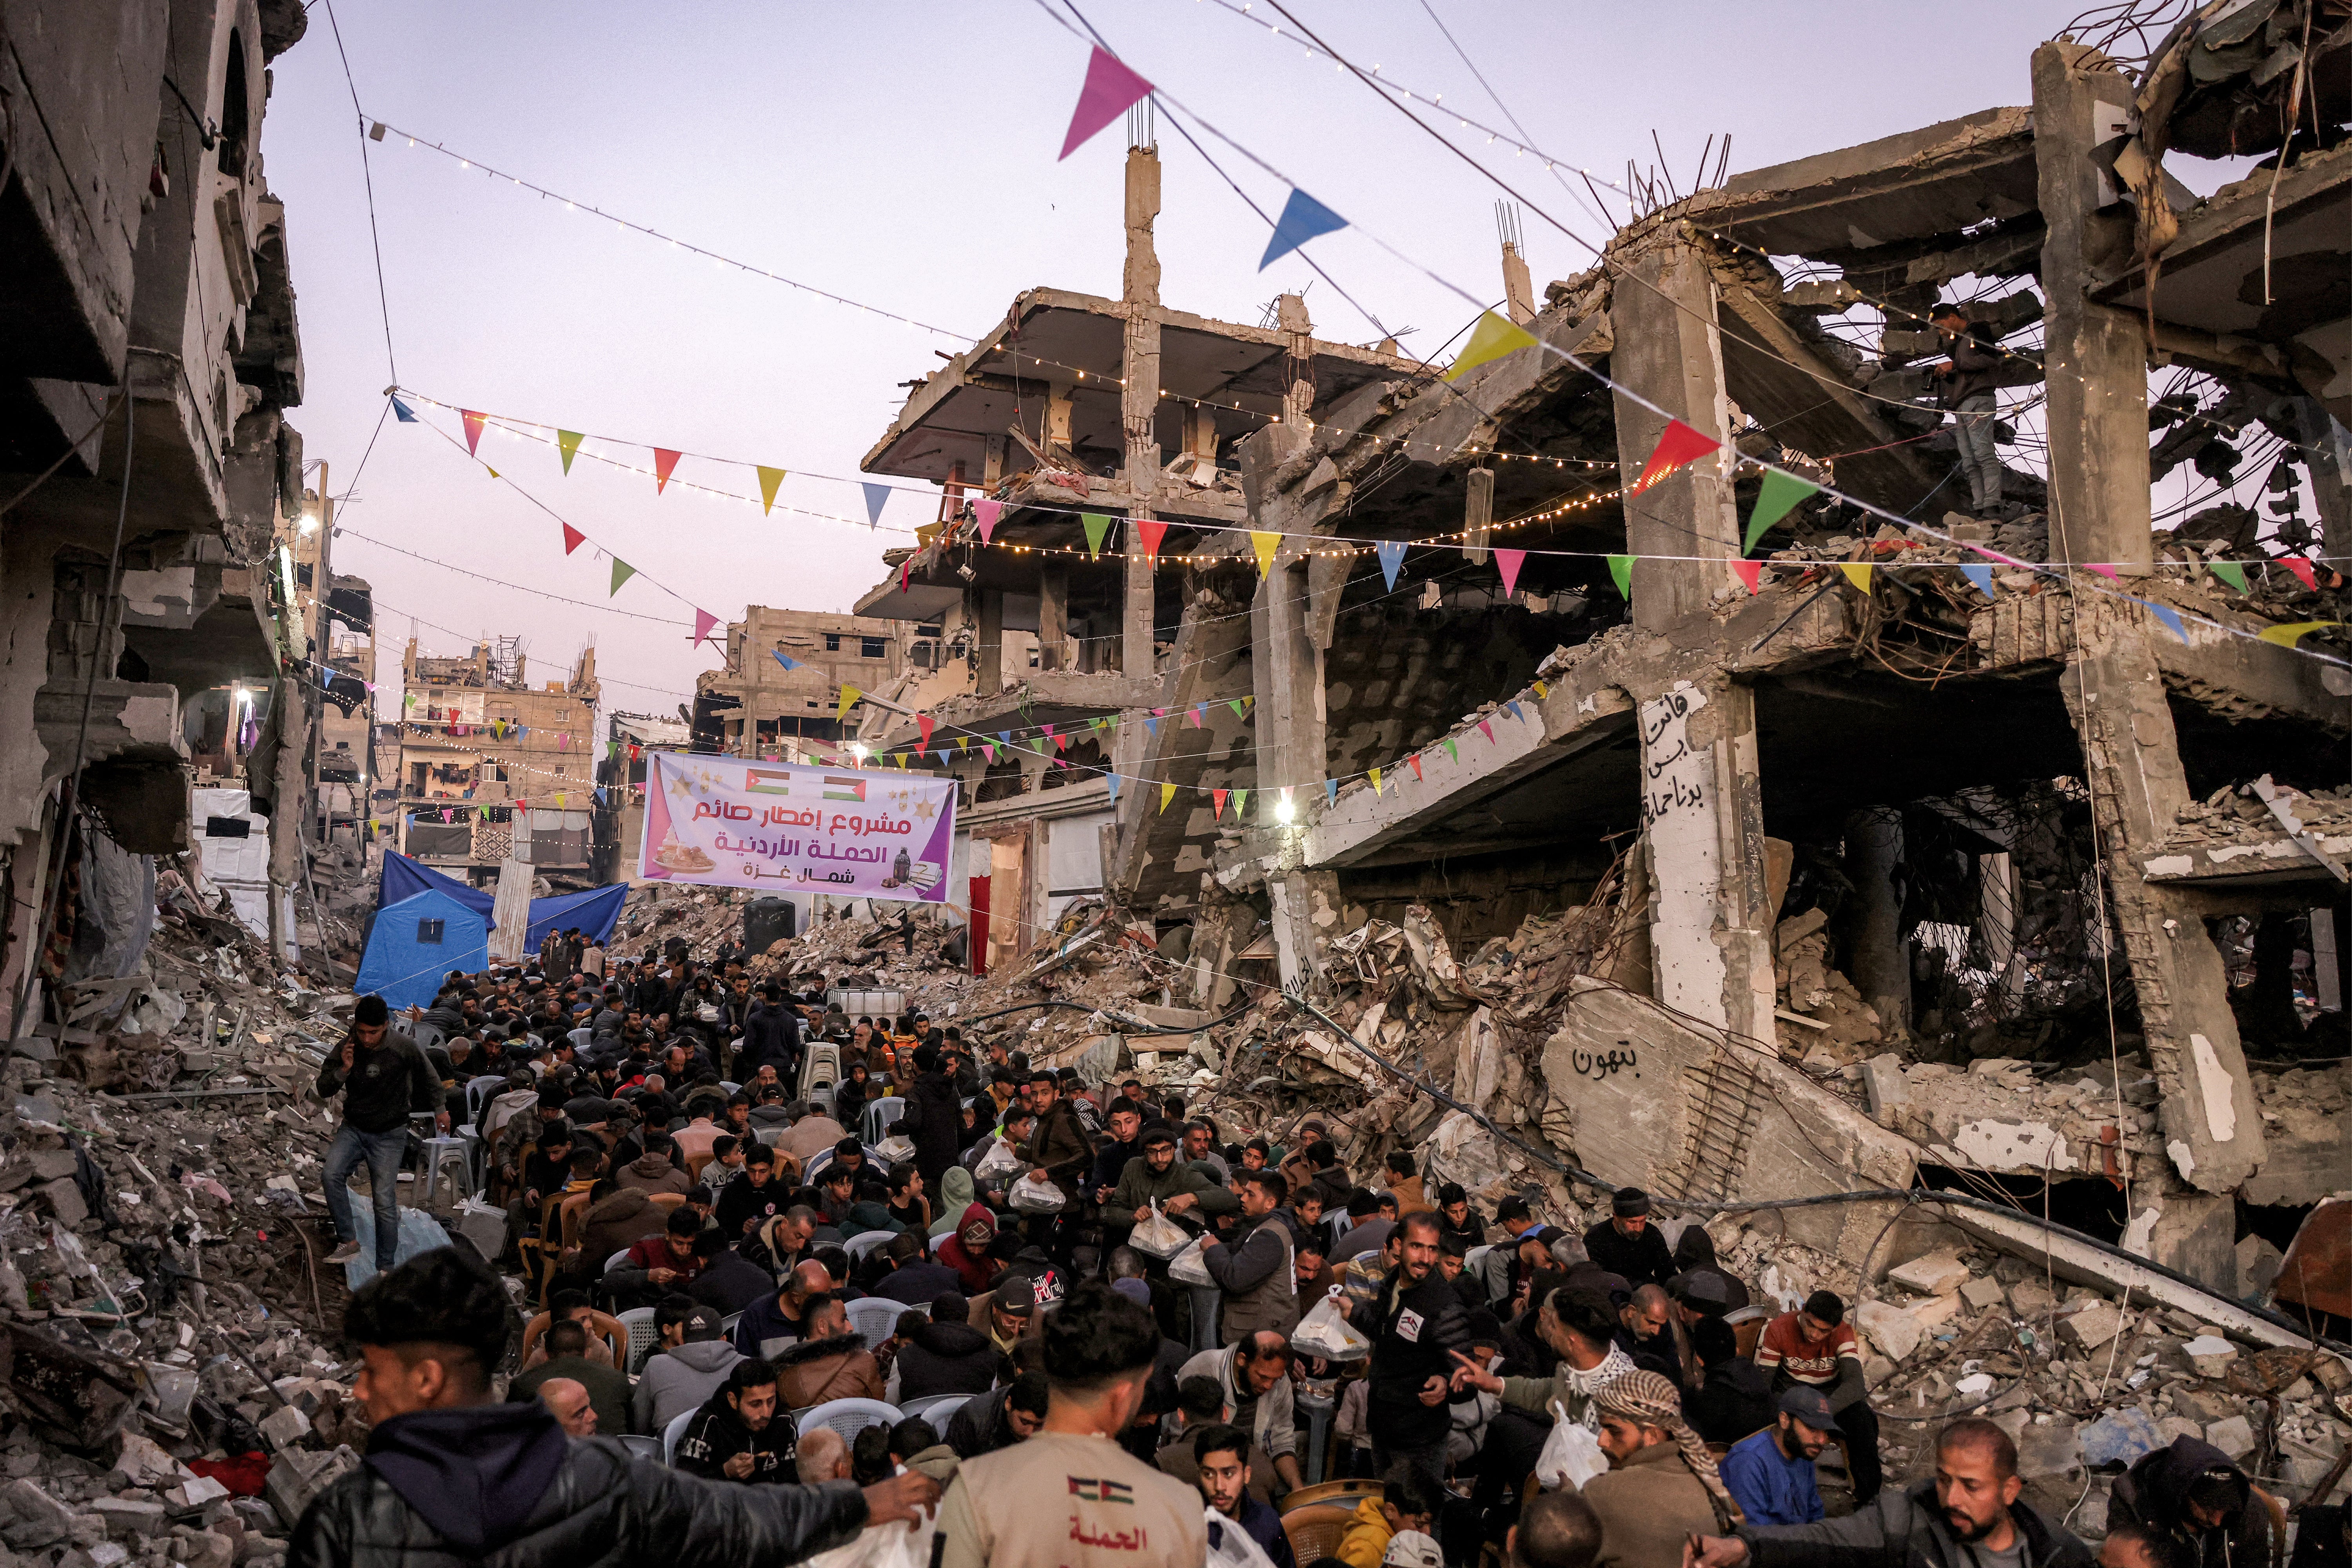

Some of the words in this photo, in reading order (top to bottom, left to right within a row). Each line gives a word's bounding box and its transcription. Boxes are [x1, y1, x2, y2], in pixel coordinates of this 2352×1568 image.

[692, 799, 753, 822] صائم
[759, 806, 822, 831] إفطار
[828, 812, 912, 836] مشروع
[714, 831, 800, 860] الأردنية
[808, 839, 887, 863] الحملة
[743, 861, 791, 880] غزة
[797, 868, 855, 884] شمال
[1069, 1515, 1147, 1551] الحملة
